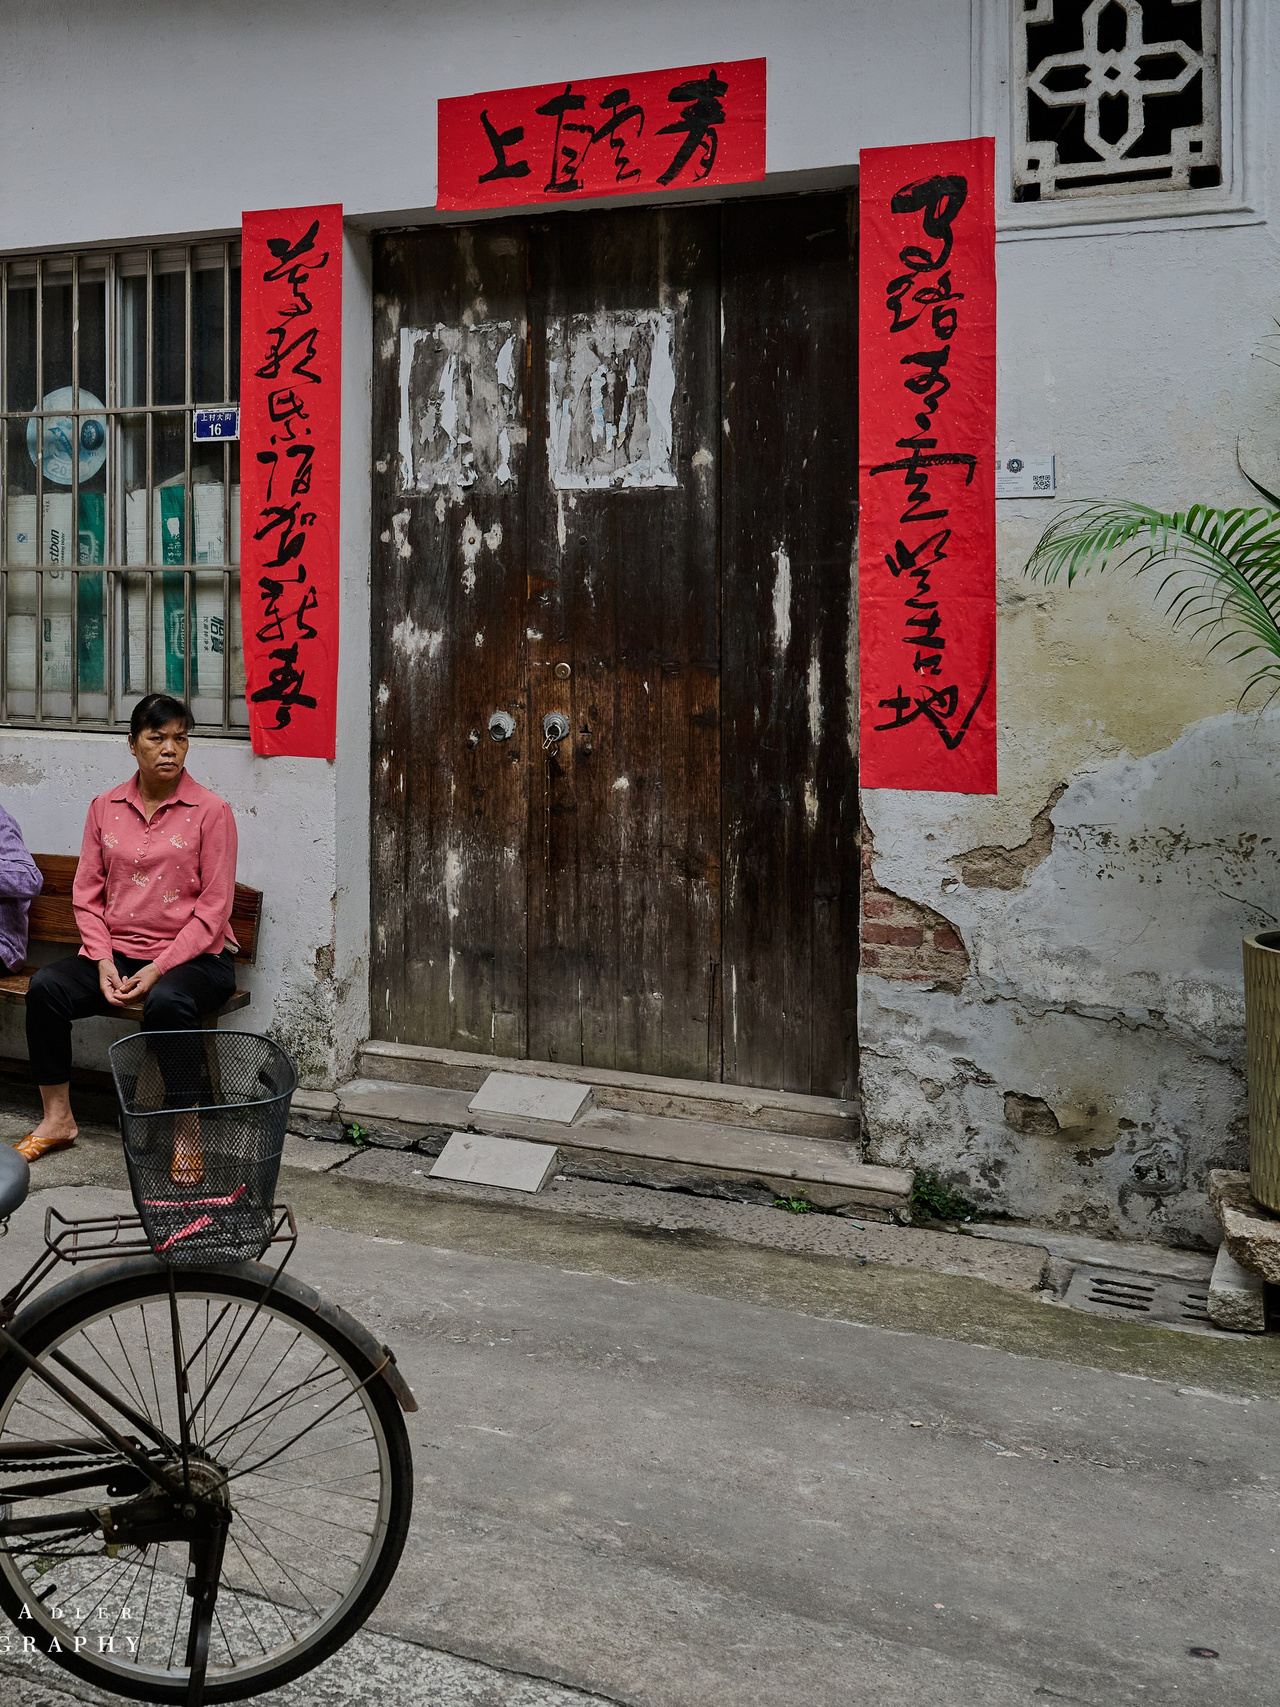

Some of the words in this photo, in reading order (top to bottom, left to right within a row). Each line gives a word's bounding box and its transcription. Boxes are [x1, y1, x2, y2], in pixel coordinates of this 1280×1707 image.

[201, 412, 232, 422] 上村大街
[209, 423, 222, 436] 16
